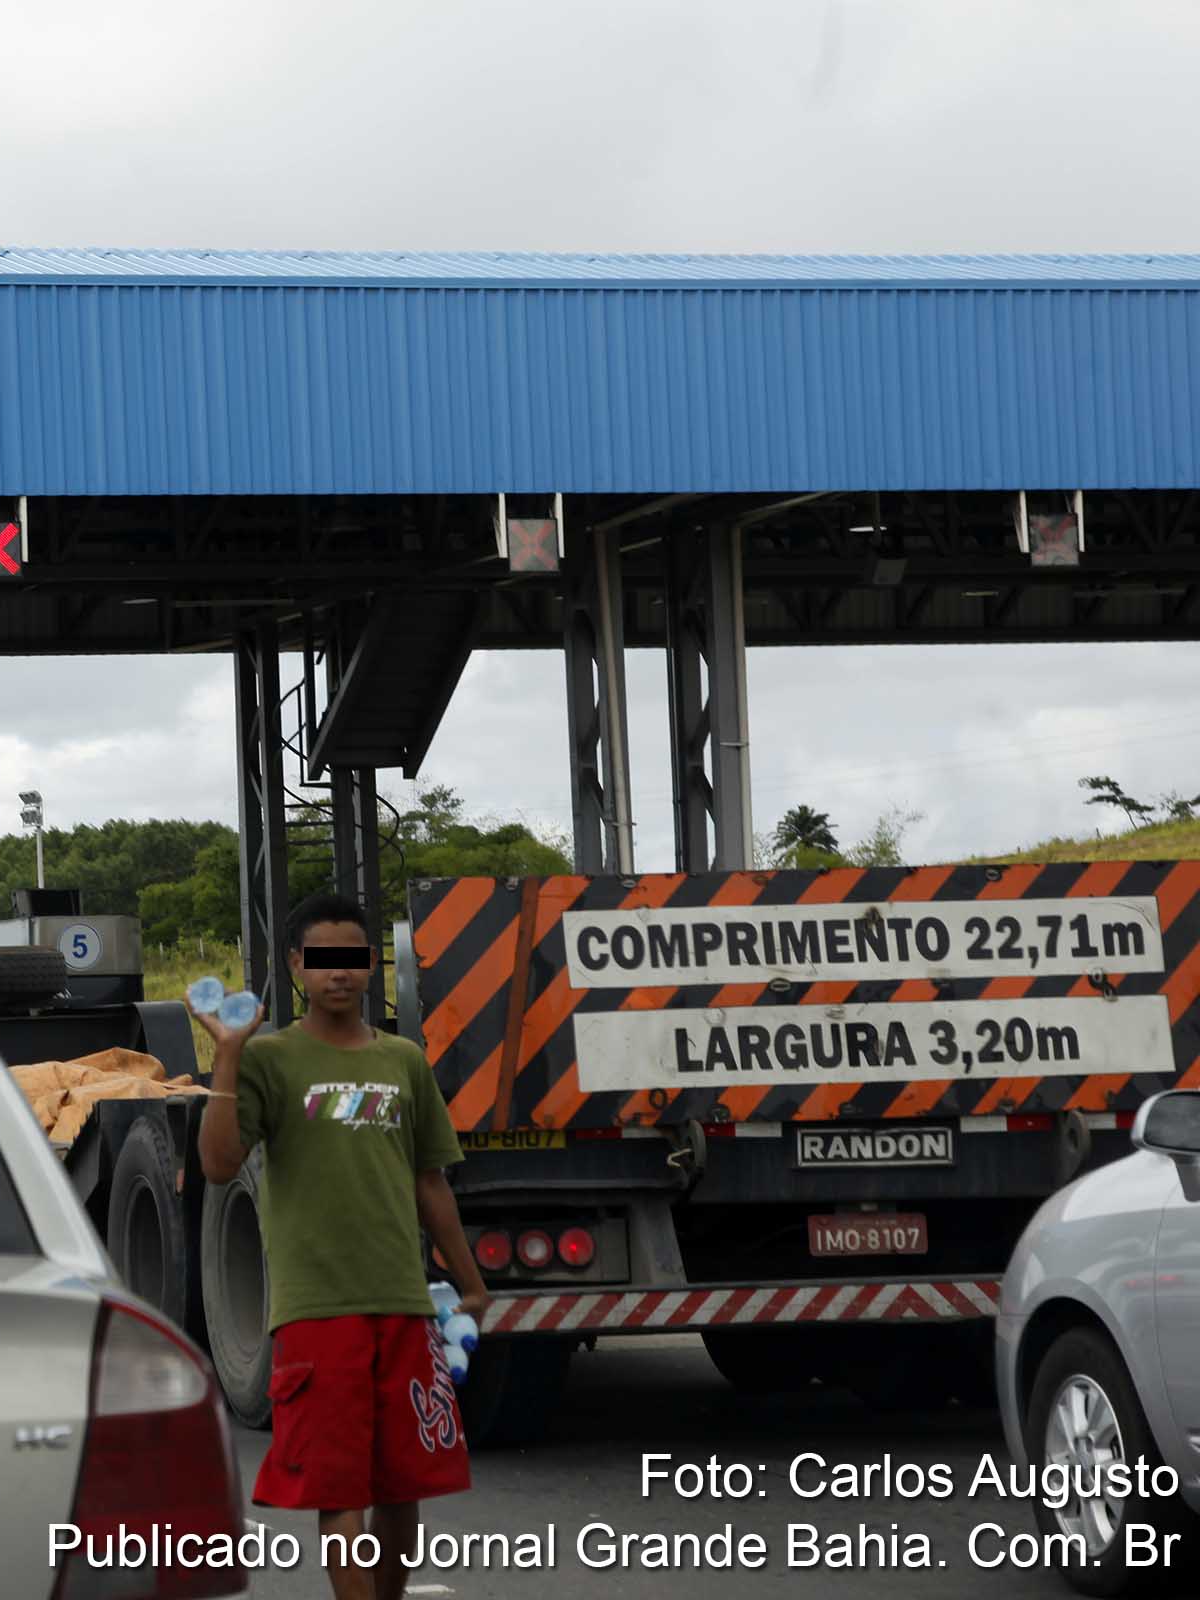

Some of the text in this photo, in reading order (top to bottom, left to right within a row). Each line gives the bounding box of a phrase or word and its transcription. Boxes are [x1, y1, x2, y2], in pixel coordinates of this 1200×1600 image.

[71, 933, 89, 959] 5
[576, 913, 1146, 971] COMPRIMENTO 22,71m
[674, 1016, 1081, 1074] LARGURA 3,20m
[802, 1134, 948, 1161] RANDON
